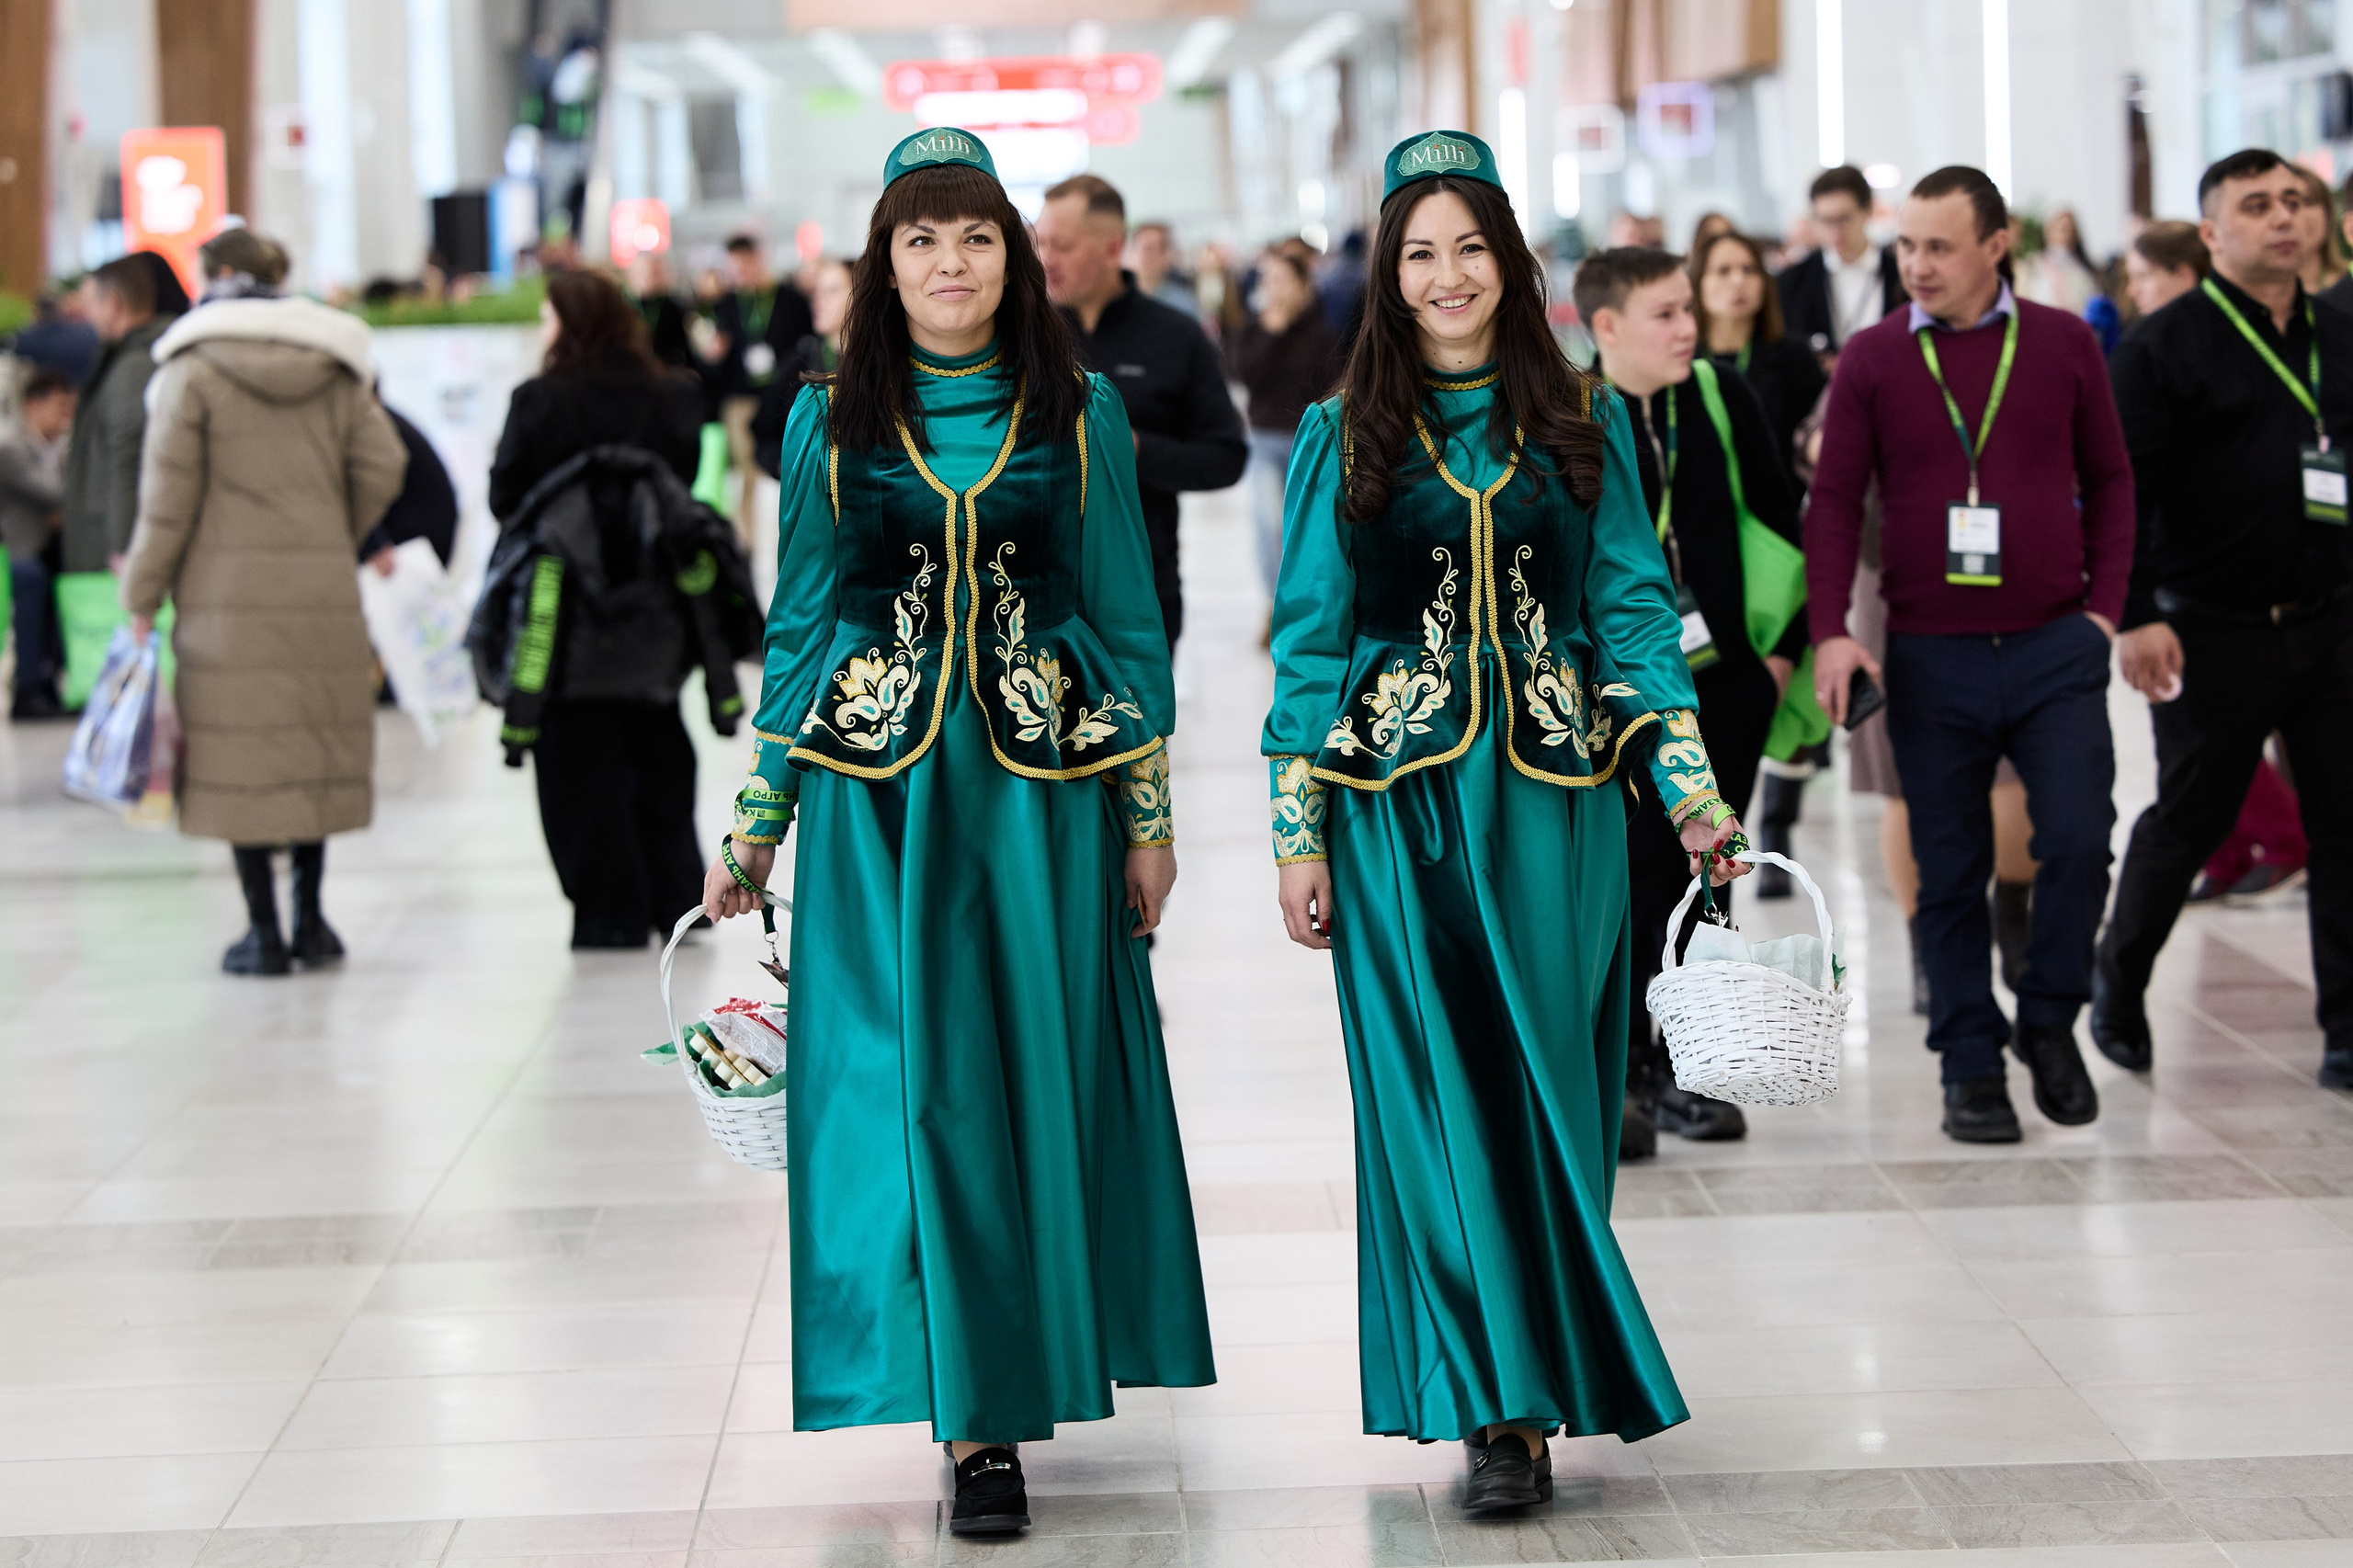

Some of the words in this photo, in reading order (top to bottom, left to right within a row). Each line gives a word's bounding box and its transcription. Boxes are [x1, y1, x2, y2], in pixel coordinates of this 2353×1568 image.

[916, 135, 971, 155] Milli
[1412, 143, 1465, 167] Milli
[753, 790, 781, 801] АГРО
[1689, 797, 1723, 817] АЗАНЬ
